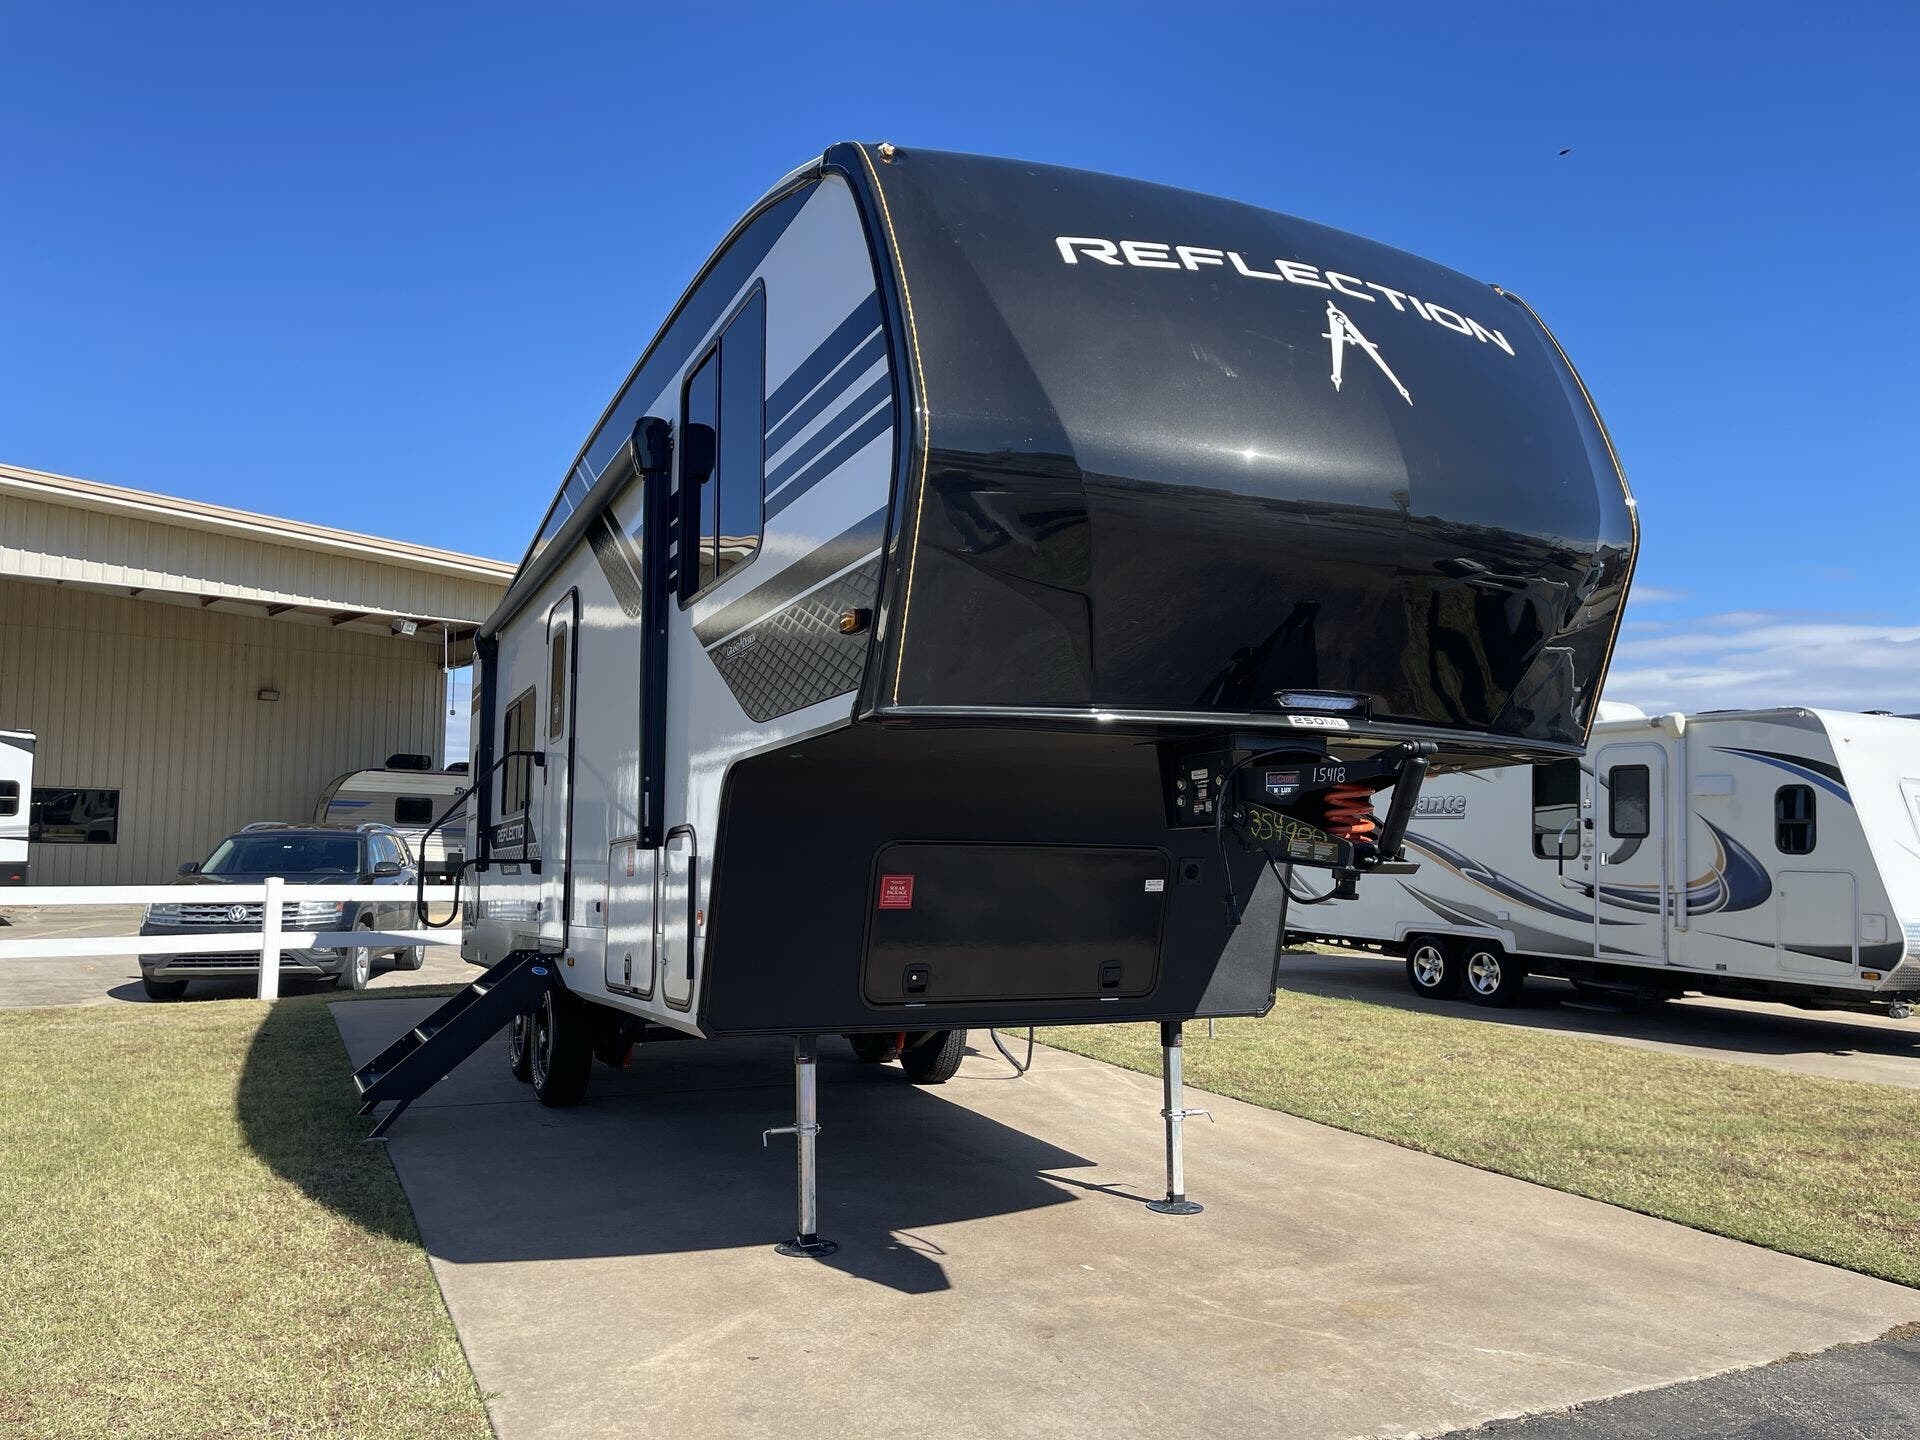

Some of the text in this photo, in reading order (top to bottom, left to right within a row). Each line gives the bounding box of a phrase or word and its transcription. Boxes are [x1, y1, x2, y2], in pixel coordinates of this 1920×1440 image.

[1055, 236, 1516, 357] REFLECTION
[1312, 766, 1346, 783] 15418
[1413, 795, 1467, 814] ance
[496, 823, 526, 844] REFLECTIO
